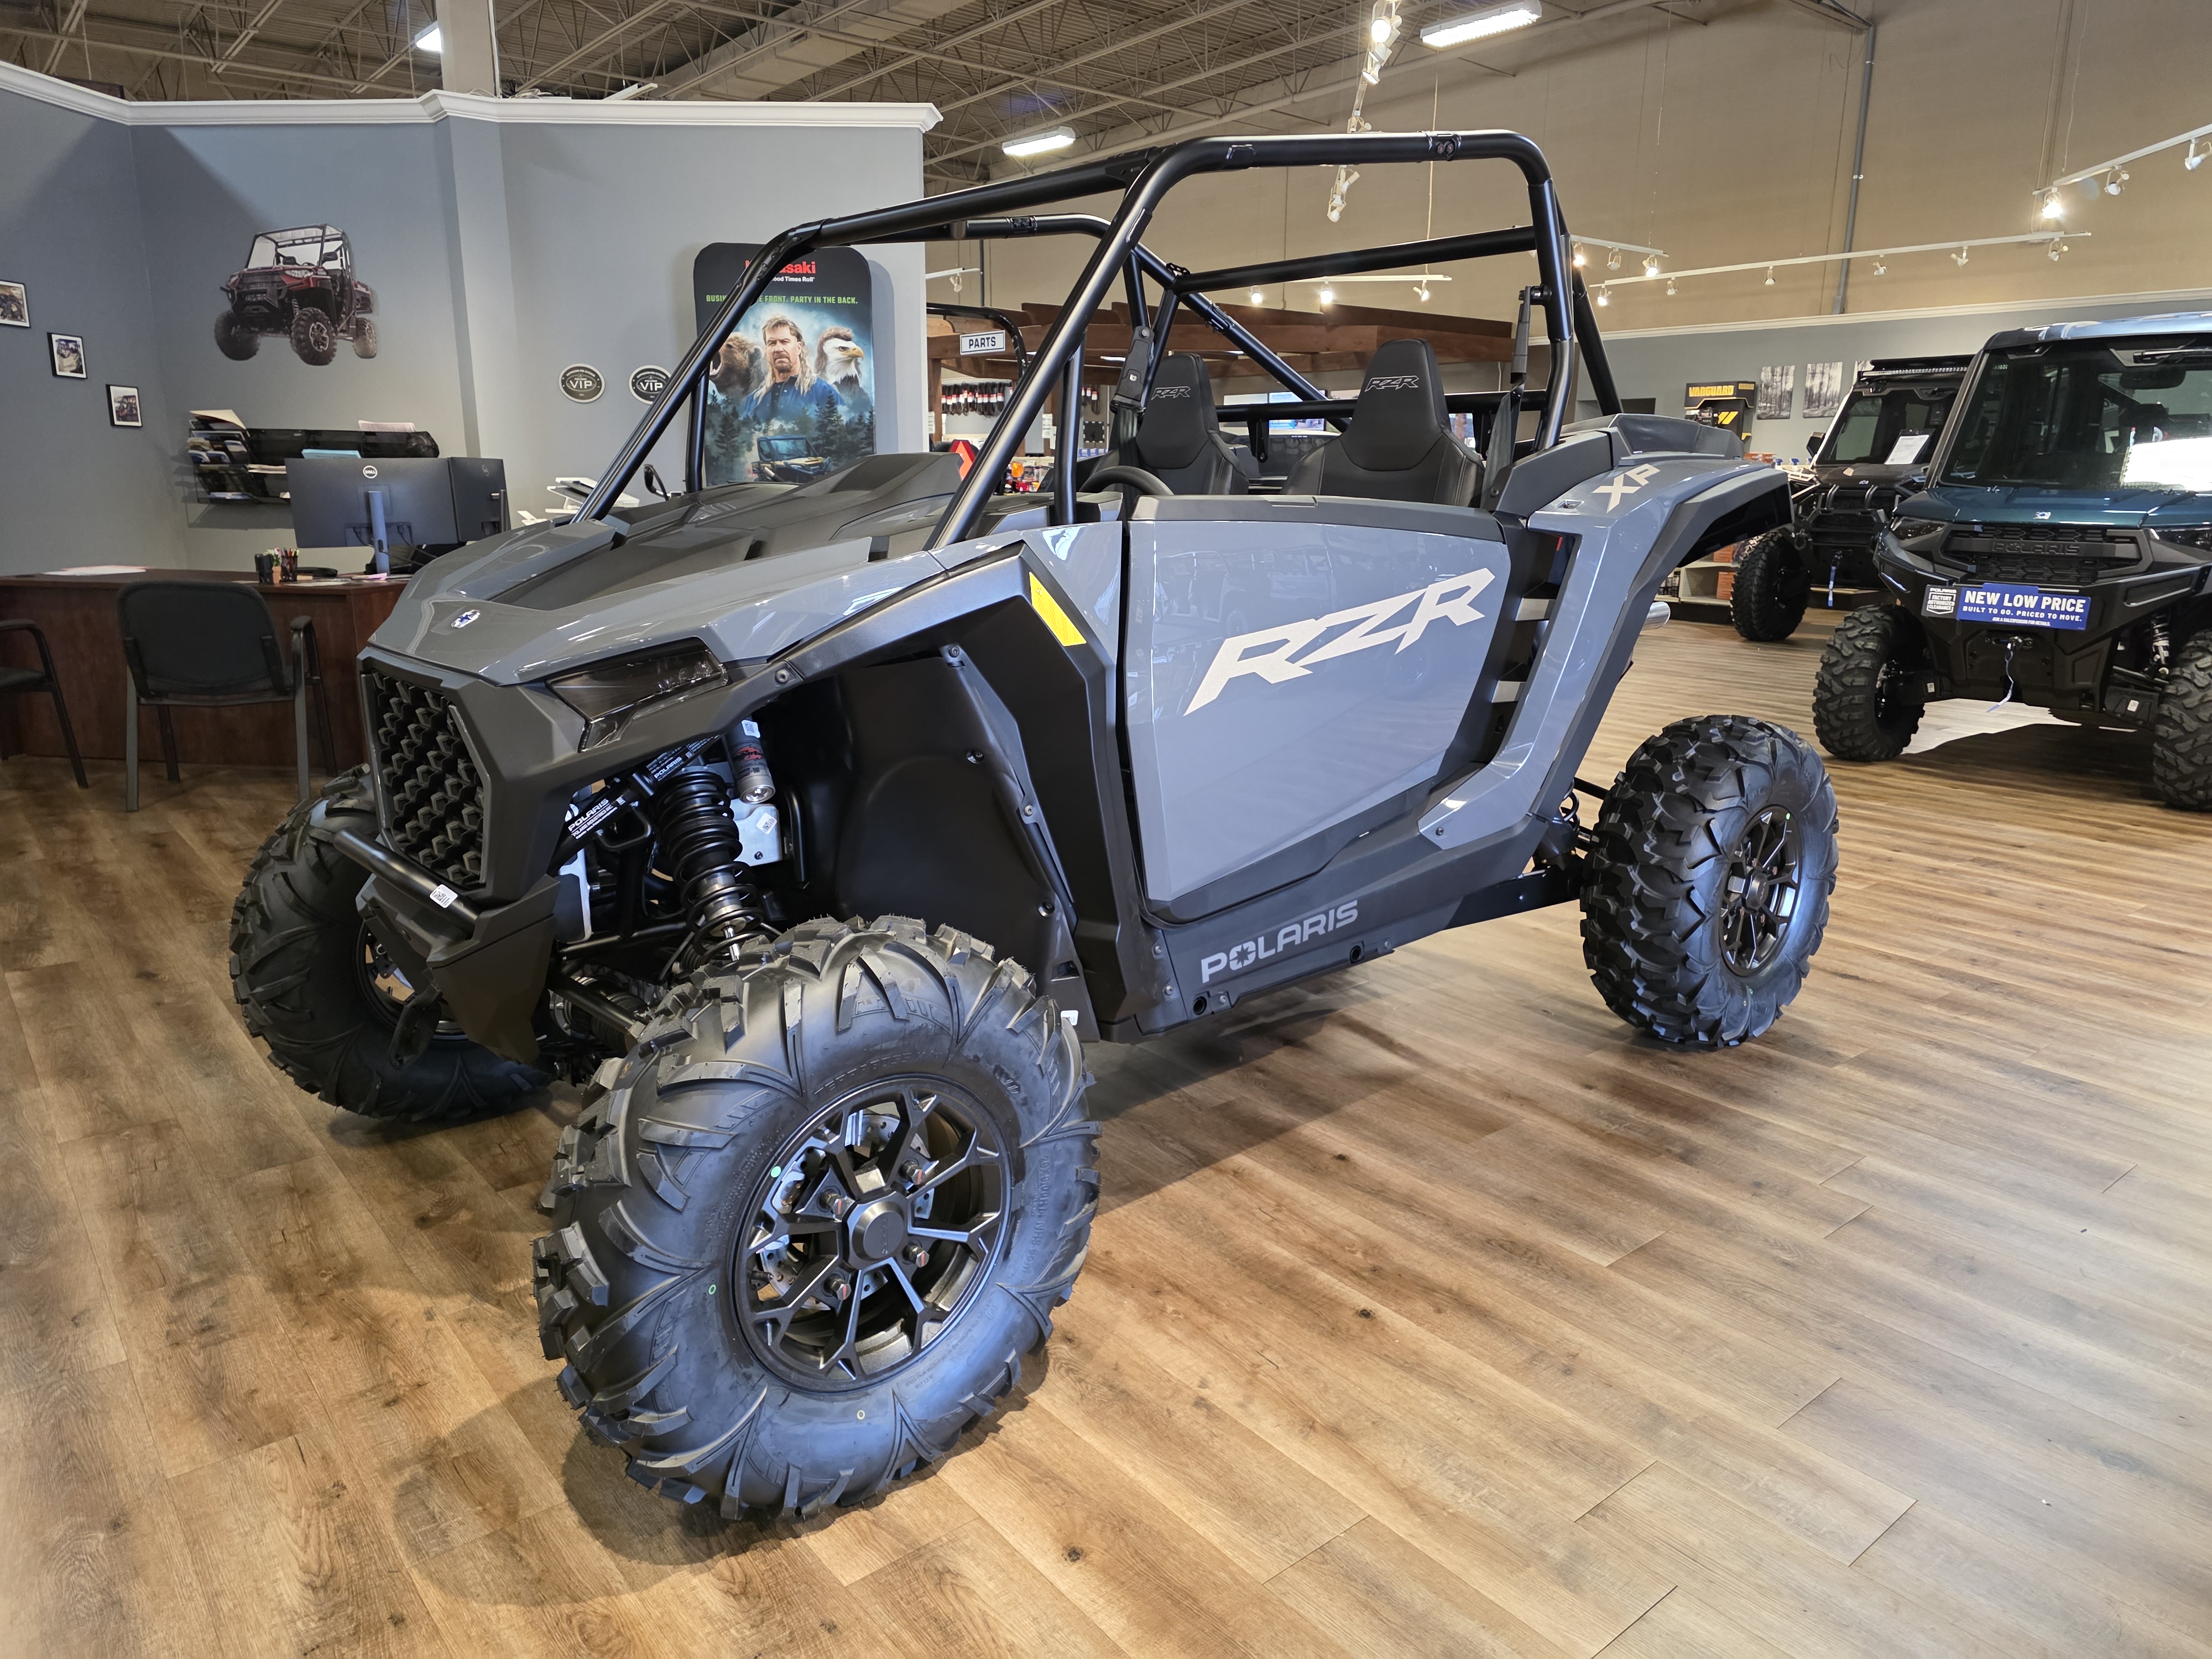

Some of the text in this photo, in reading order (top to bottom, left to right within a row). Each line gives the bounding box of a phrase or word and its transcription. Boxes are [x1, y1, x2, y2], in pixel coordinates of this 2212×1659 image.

[968, 336, 996, 349] PARTS
[570, 380, 592, 389] VIP
[640, 382, 663, 391] VIP
[1689, 385, 1735, 397] VANGUARD
[1590, 463, 1661, 513] XP
[1992, 542, 2080, 555] POLARIS
[1964, 590, 2086, 613] NEW LOW PRICE
[2016, 610, 2045, 618] PRICED
[2059, 613, 2083, 622] MOVE.
[1183, 567, 1495, 717] RZR
[654, 756, 683, 779] POLARIS
[567, 798, 609, 832] POLARIS
[1201, 899, 1359, 984] POLARIS
